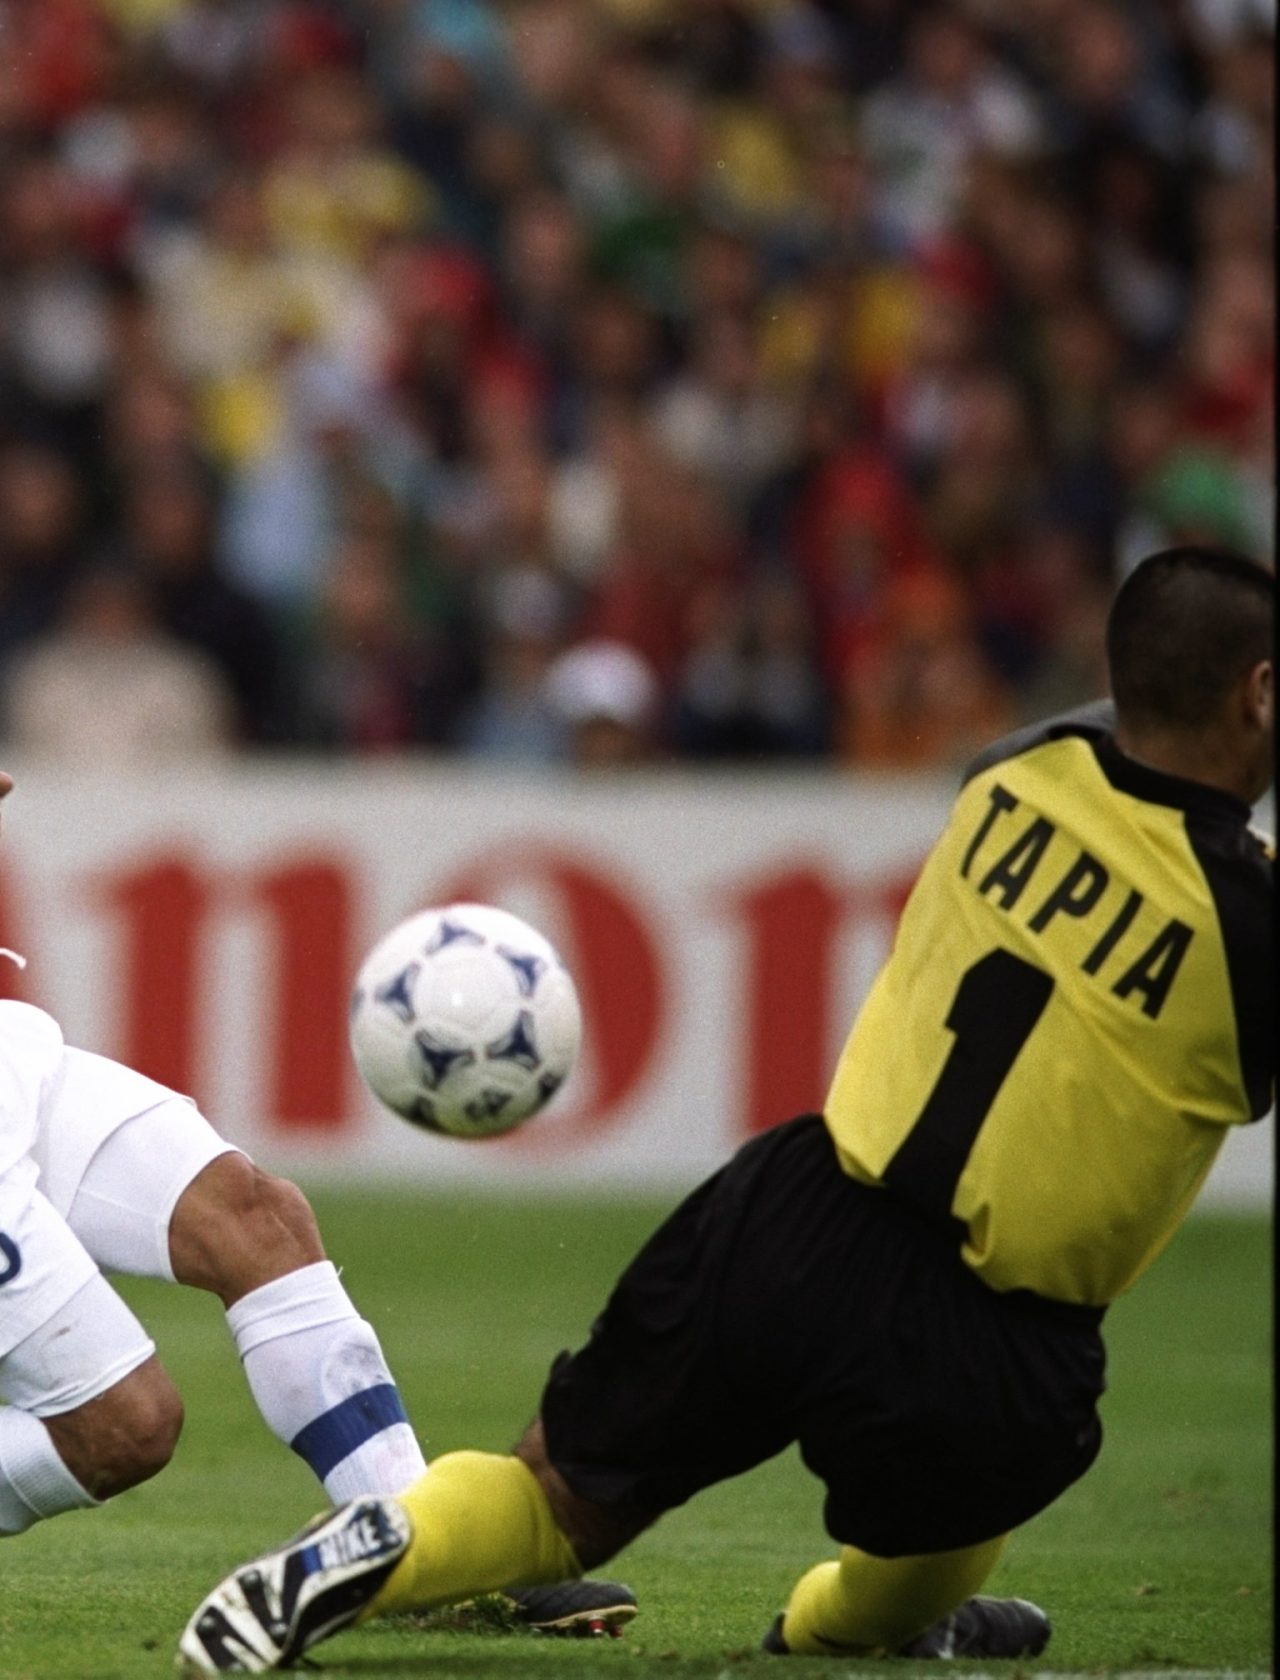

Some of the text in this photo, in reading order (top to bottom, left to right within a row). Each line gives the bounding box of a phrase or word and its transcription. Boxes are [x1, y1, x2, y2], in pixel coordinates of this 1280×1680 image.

[961, 784, 1194, 1020] TAPIA
[877, 945, 1055, 1218] 1
[319, 1517, 382, 1570] NIKE
